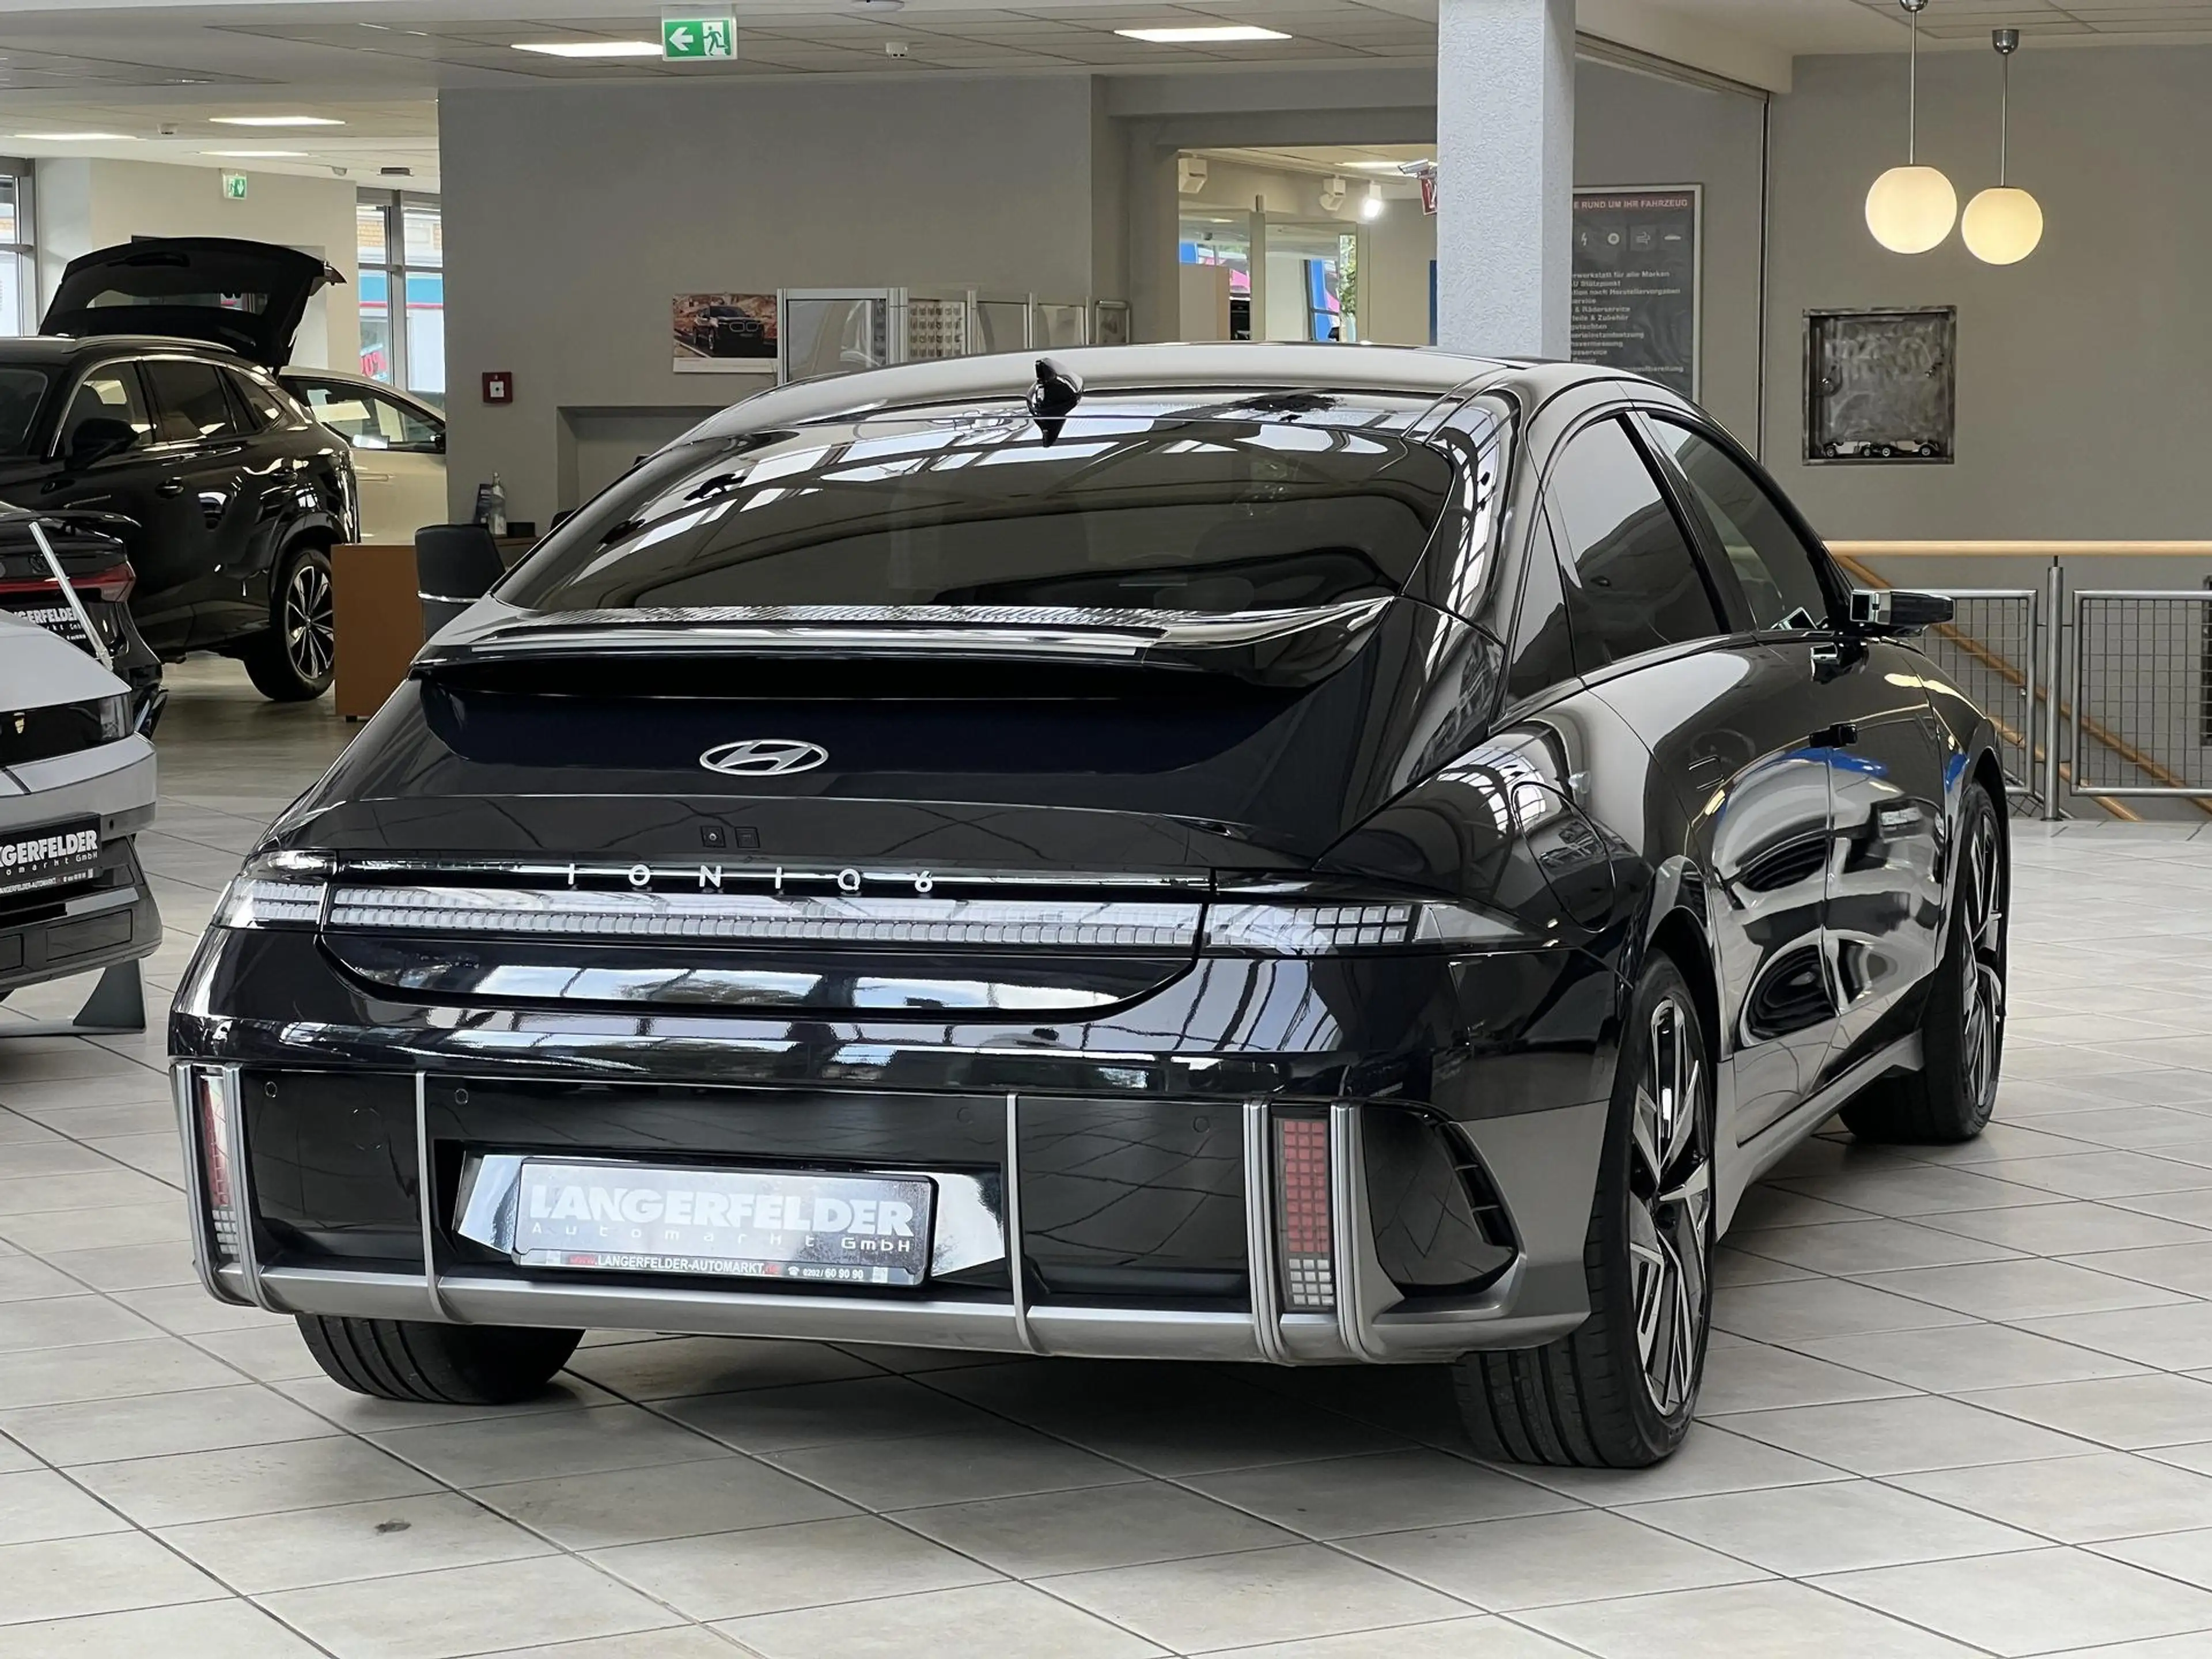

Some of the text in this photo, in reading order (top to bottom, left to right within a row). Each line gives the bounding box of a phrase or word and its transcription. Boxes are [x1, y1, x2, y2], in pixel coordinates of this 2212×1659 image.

[1581, 201, 1606, 209] RUND
[1608, 200, 1622, 209] UM
[1641, 199, 1688, 207] FAHRZEUG
[14, 607, 78, 624] GERFELDE
[567, 863, 933, 893] IONIQ 6
[530, 1184, 915, 1237] LANGERFELDER
[840, 1237, 911, 1252] GmbH
[825, 1267, 836, 1278] 60
